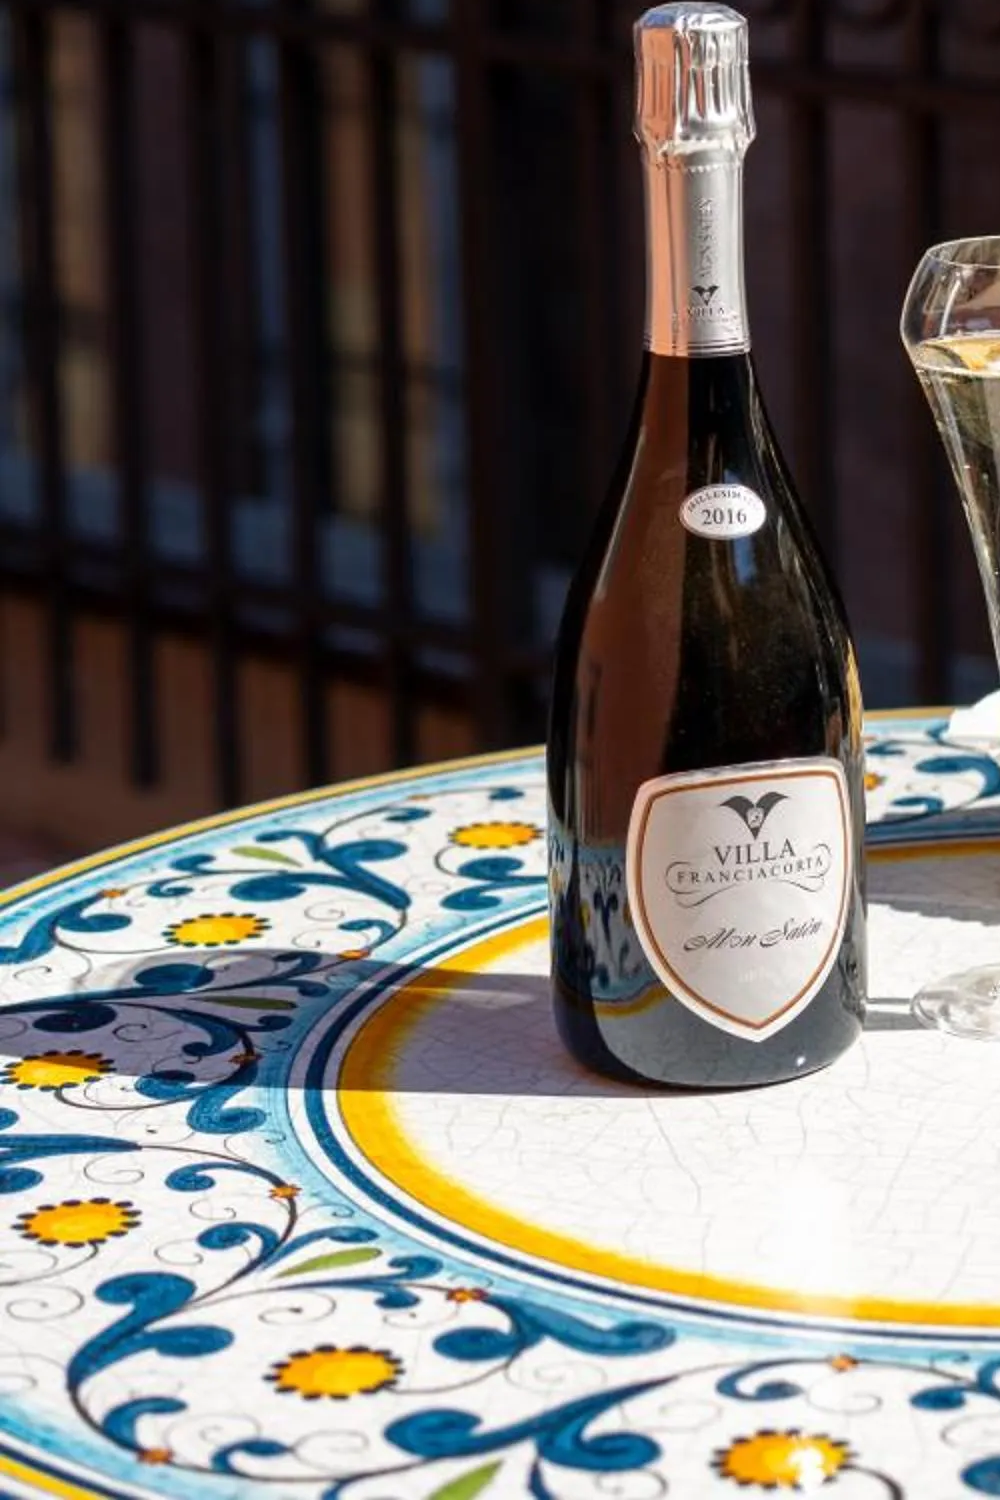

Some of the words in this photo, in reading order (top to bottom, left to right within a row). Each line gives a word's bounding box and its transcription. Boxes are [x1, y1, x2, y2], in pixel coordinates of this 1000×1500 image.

[701, 507, 748, 525] 2016
[714, 837, 796, 867] VILLA
[677, 855, 824, 885] FRANCIACORTA
[683, 926, 757, 952] Mon
